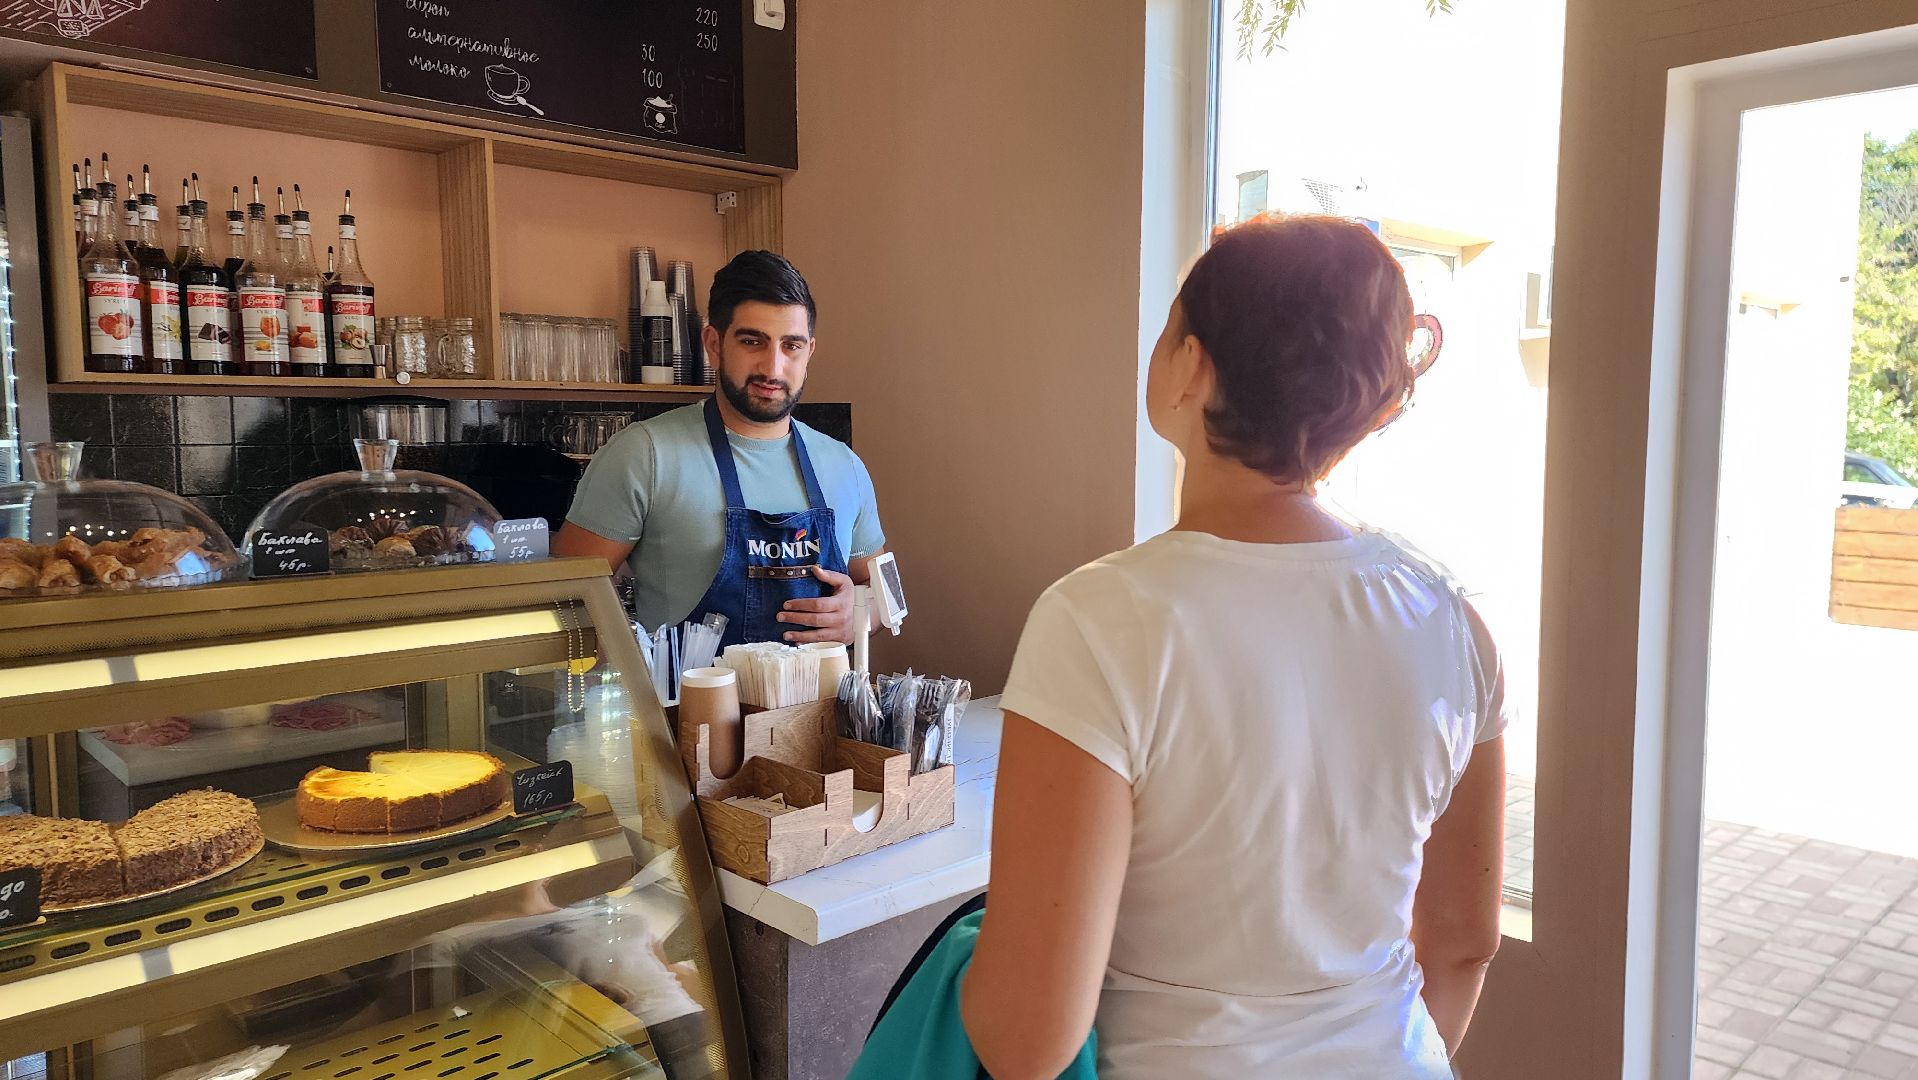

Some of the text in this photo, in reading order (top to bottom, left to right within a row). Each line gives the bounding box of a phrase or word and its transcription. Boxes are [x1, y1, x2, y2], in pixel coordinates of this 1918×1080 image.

[695, 7, 718, 27] 220
[696, 32, 718, 51] 250
[408, 55, 470, 78] молоко
[641, 68, 663, 88] 100
[258, 532, 323, 546] Баклава
[748, 537, 821, 559] MONIN
